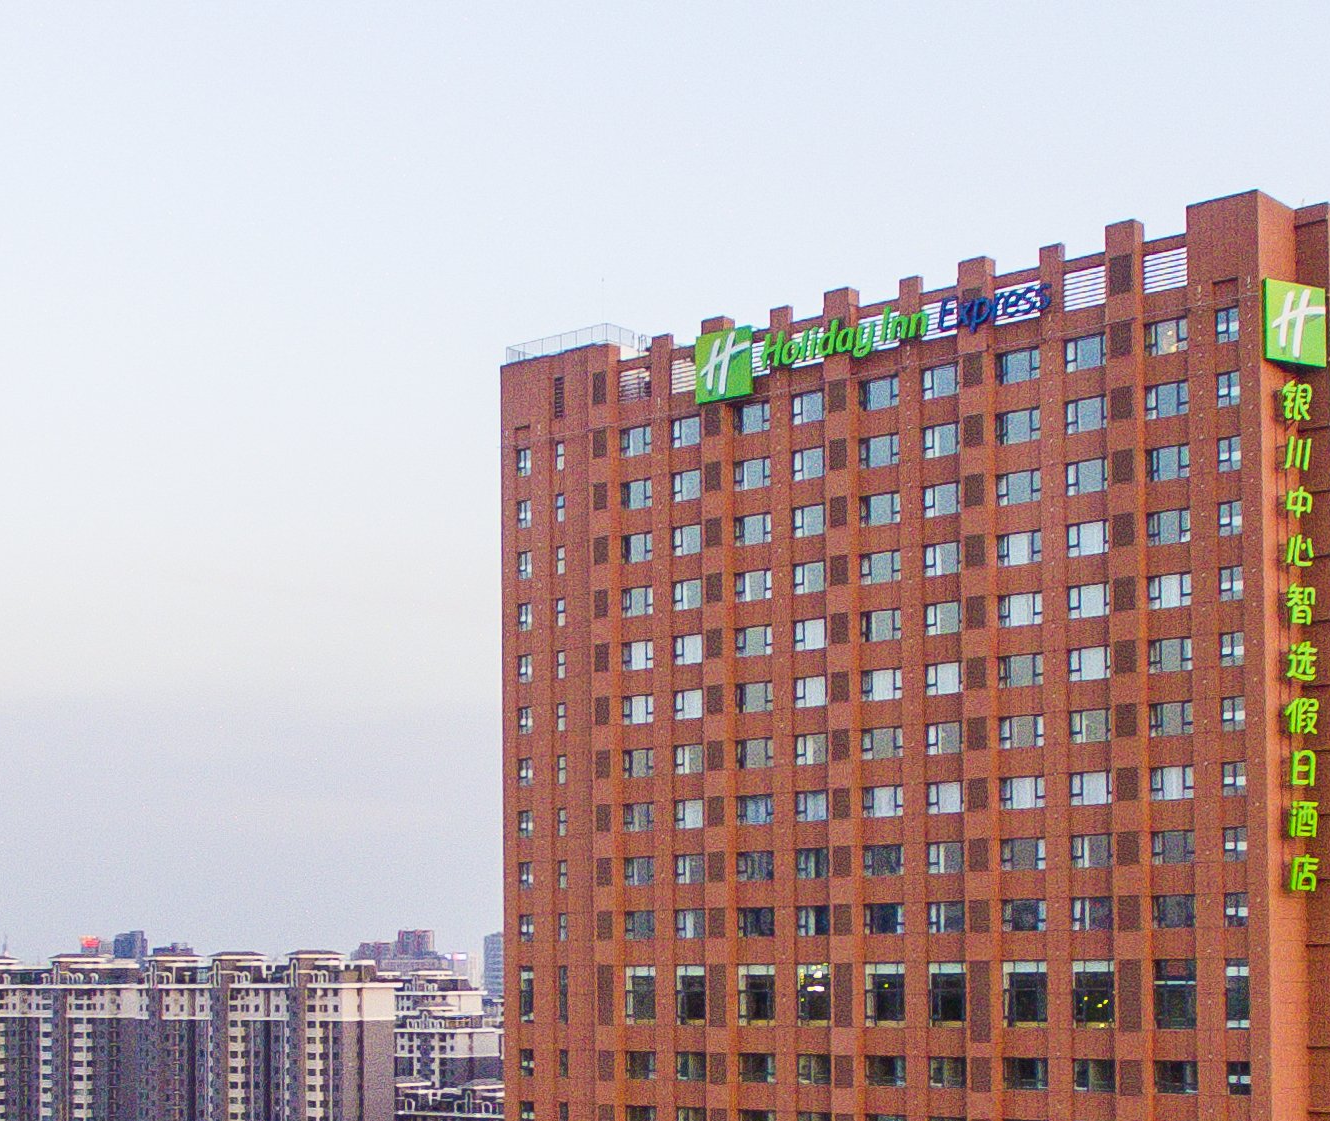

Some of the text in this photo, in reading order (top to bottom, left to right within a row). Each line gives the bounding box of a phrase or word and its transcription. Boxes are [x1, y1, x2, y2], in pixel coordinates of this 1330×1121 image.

[760, 283, 1052, 368] Holiday Inn Express
[1282, 379, 1318, 894] 银川中心智选假日酒店
